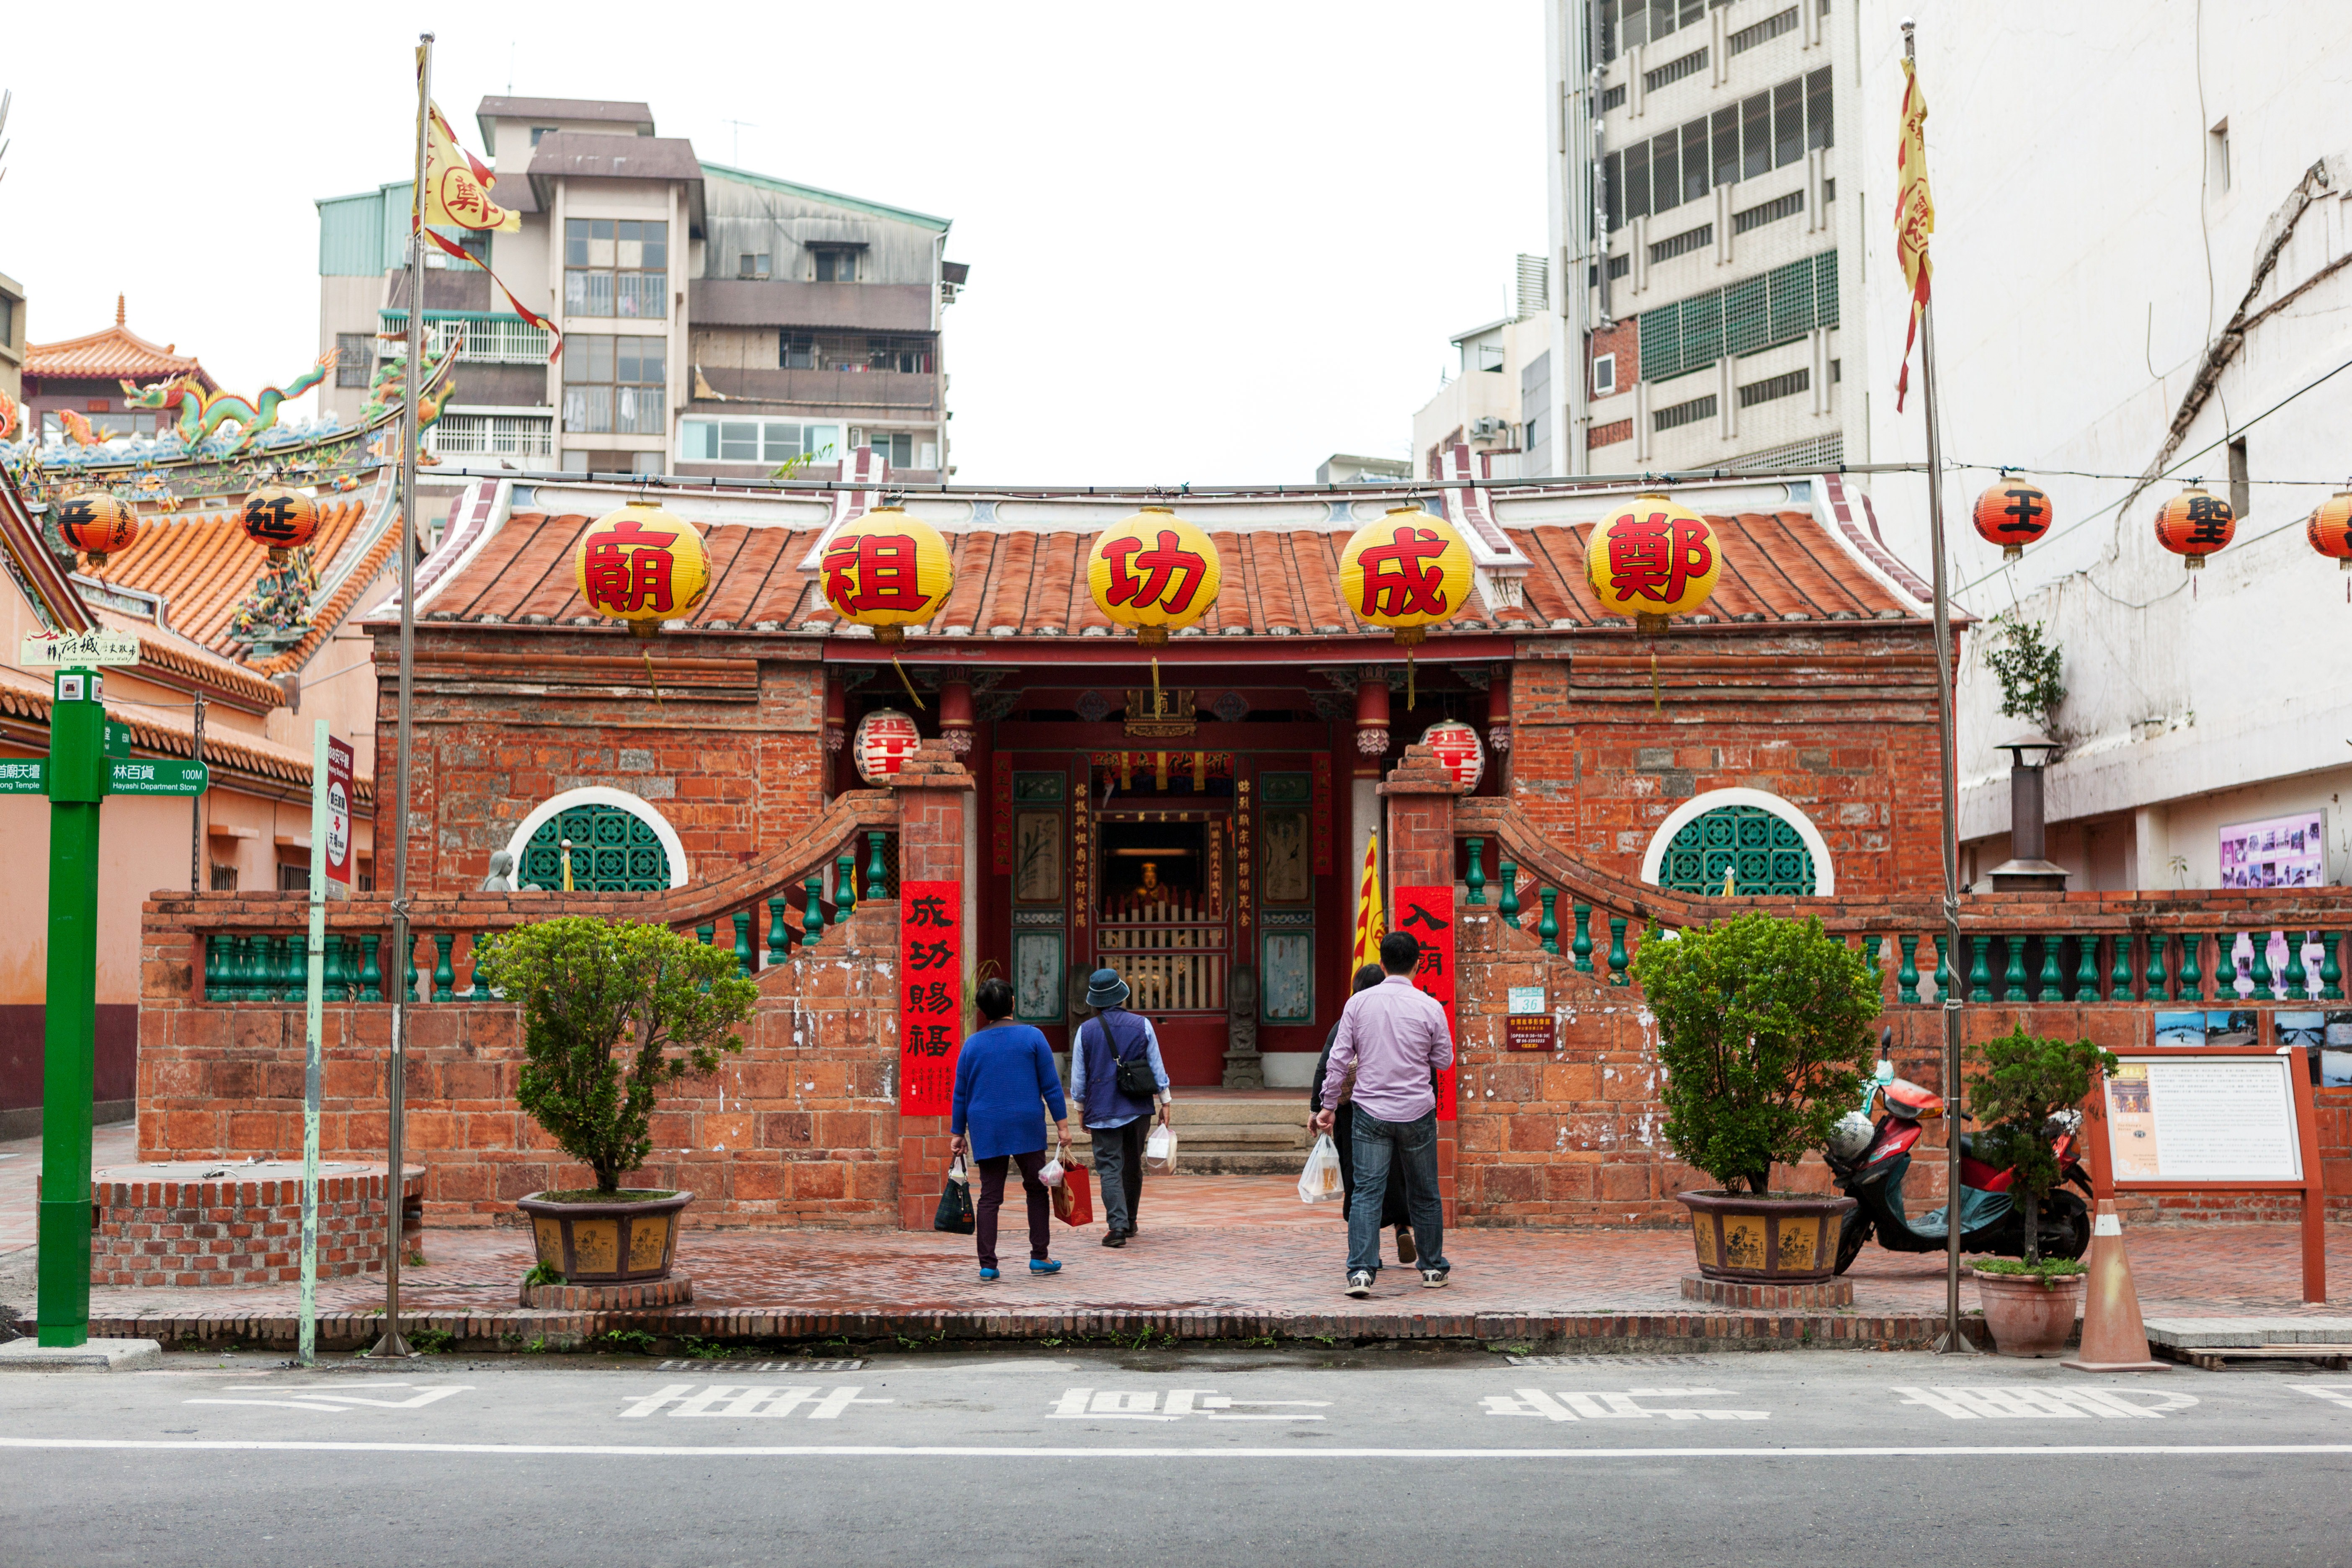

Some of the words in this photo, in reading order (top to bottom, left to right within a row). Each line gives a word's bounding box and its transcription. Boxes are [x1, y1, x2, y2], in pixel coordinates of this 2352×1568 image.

[245, 497, 299, 541] 延
[1997, 489, 2044, 533] 王
[2186, 497, 2232, 544] 聖
[585, 521, 679, 613] 廟
[822, 534, 932, 616] 祖
[1101, 529, 1207, 614] 功
[1357, 526, 1450, 617] 成
[1607, 513, 1712, 604] 鄭
[0, 764, 40, 779] 首廟天壇
[15, 781, 40, 790] Temple
[113, 765, 155, 780] 林百貨
[113, 782, 139, 790] Hayashi
[141, 783, 178, 792] Department
[181, 769, 203, 780] 100M
[906, 895, 954, 1057] 成功賜福
[1522, 999, 1537, 1010] 36
